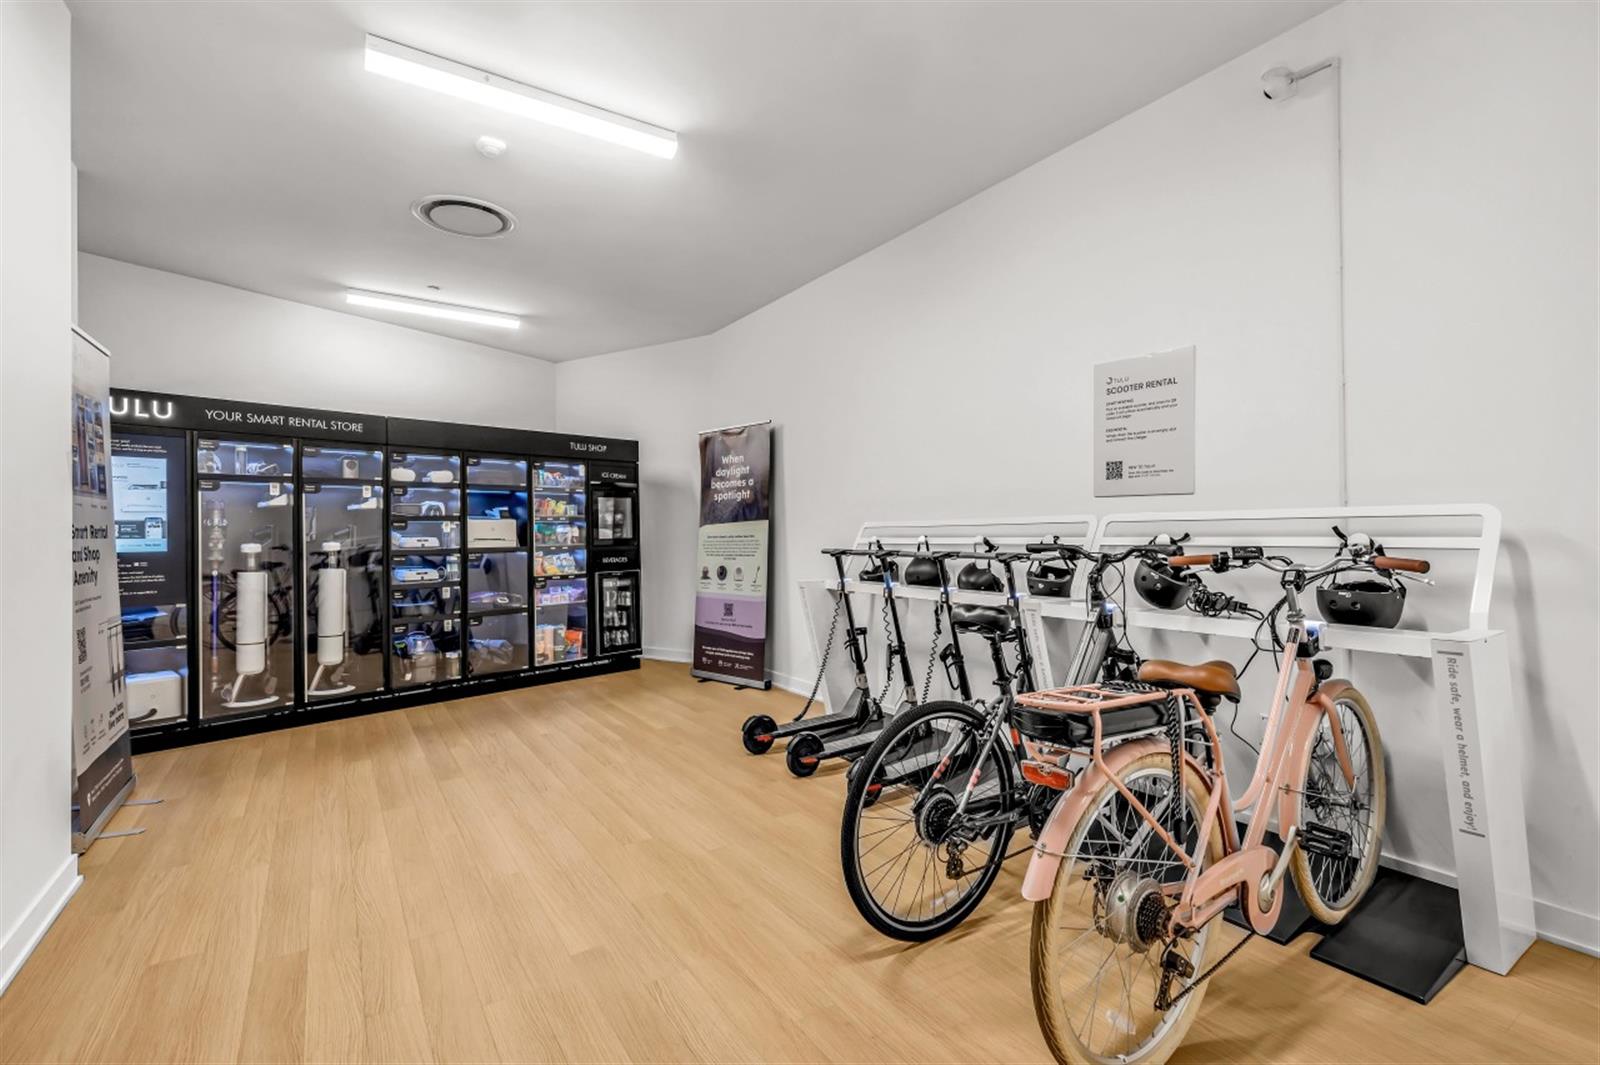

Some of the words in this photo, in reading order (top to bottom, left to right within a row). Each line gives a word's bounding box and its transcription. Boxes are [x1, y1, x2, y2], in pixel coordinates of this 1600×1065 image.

[1105, 382, 1144, 396] SCOOTER
[1145, 377, 1178, 389] RENTAL
[110, 396, 173, 419] ULU
[205, 409, 242, 421] YOUR
[247, 413, 285, 426] SMART
[288, 416, 329, 430] RENTAL
[330, 420, 364, 432] STORE
[569, 442, 588, 451] TULU
[588, 445, 607, 453] SHOP
[721, 454, 745, 465] When
[715, 466, 750, 479] daylight
[710, 478, 747, 490] becomes
[748, 478, 755, 487] a
[713, 489, 751, 503] spotlight
[83, 546, 101, 564] Shop
[1447, 657, 1460, 679] Ride
[1449, 681, 1462, 705] safe,
[1453, 707, 1463, 732] wear
[1456, 733, 1465, 741] a
[1458, 742, 1470, 778] helmet,
[1462, 780, 1474, 800] and
[1463, 801, 1478, 831] enjoy!
